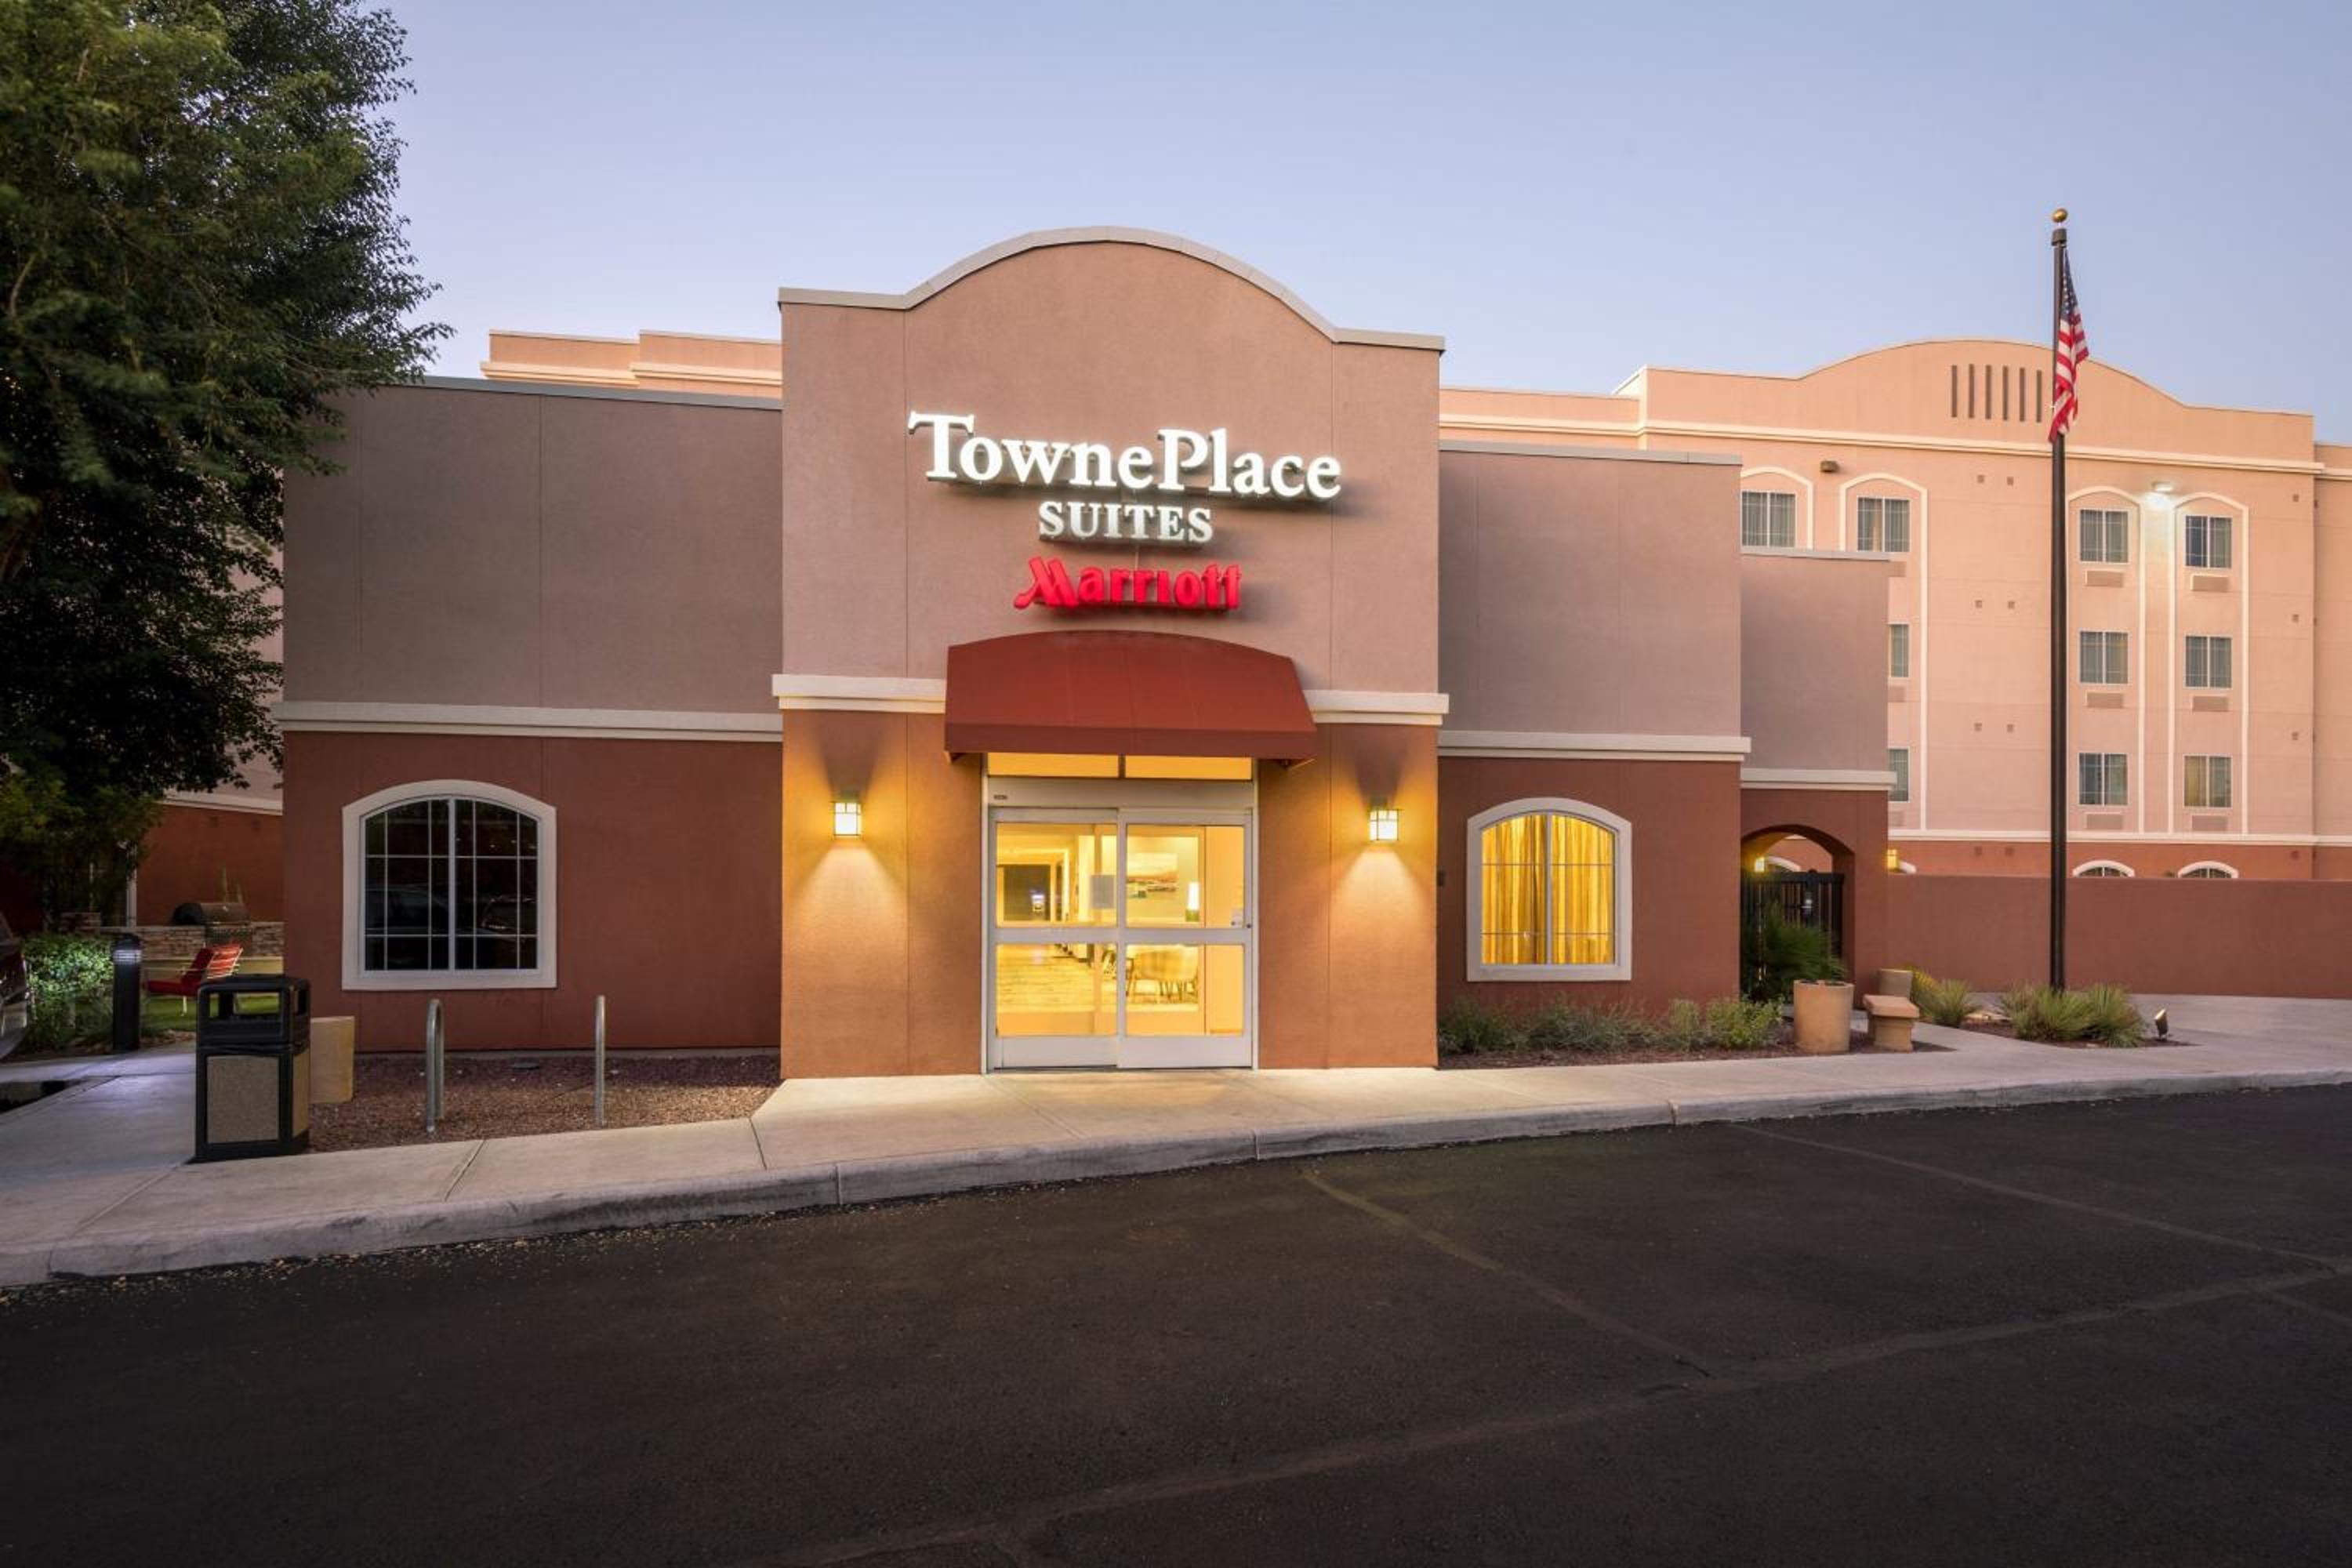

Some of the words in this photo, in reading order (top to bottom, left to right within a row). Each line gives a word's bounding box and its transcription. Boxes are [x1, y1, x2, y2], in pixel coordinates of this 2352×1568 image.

[908, 411, 1341, 499] TownePlace
[1039, 500, 1213, 542] SUITES
[1014, 556, 1241, 609] Marriott
